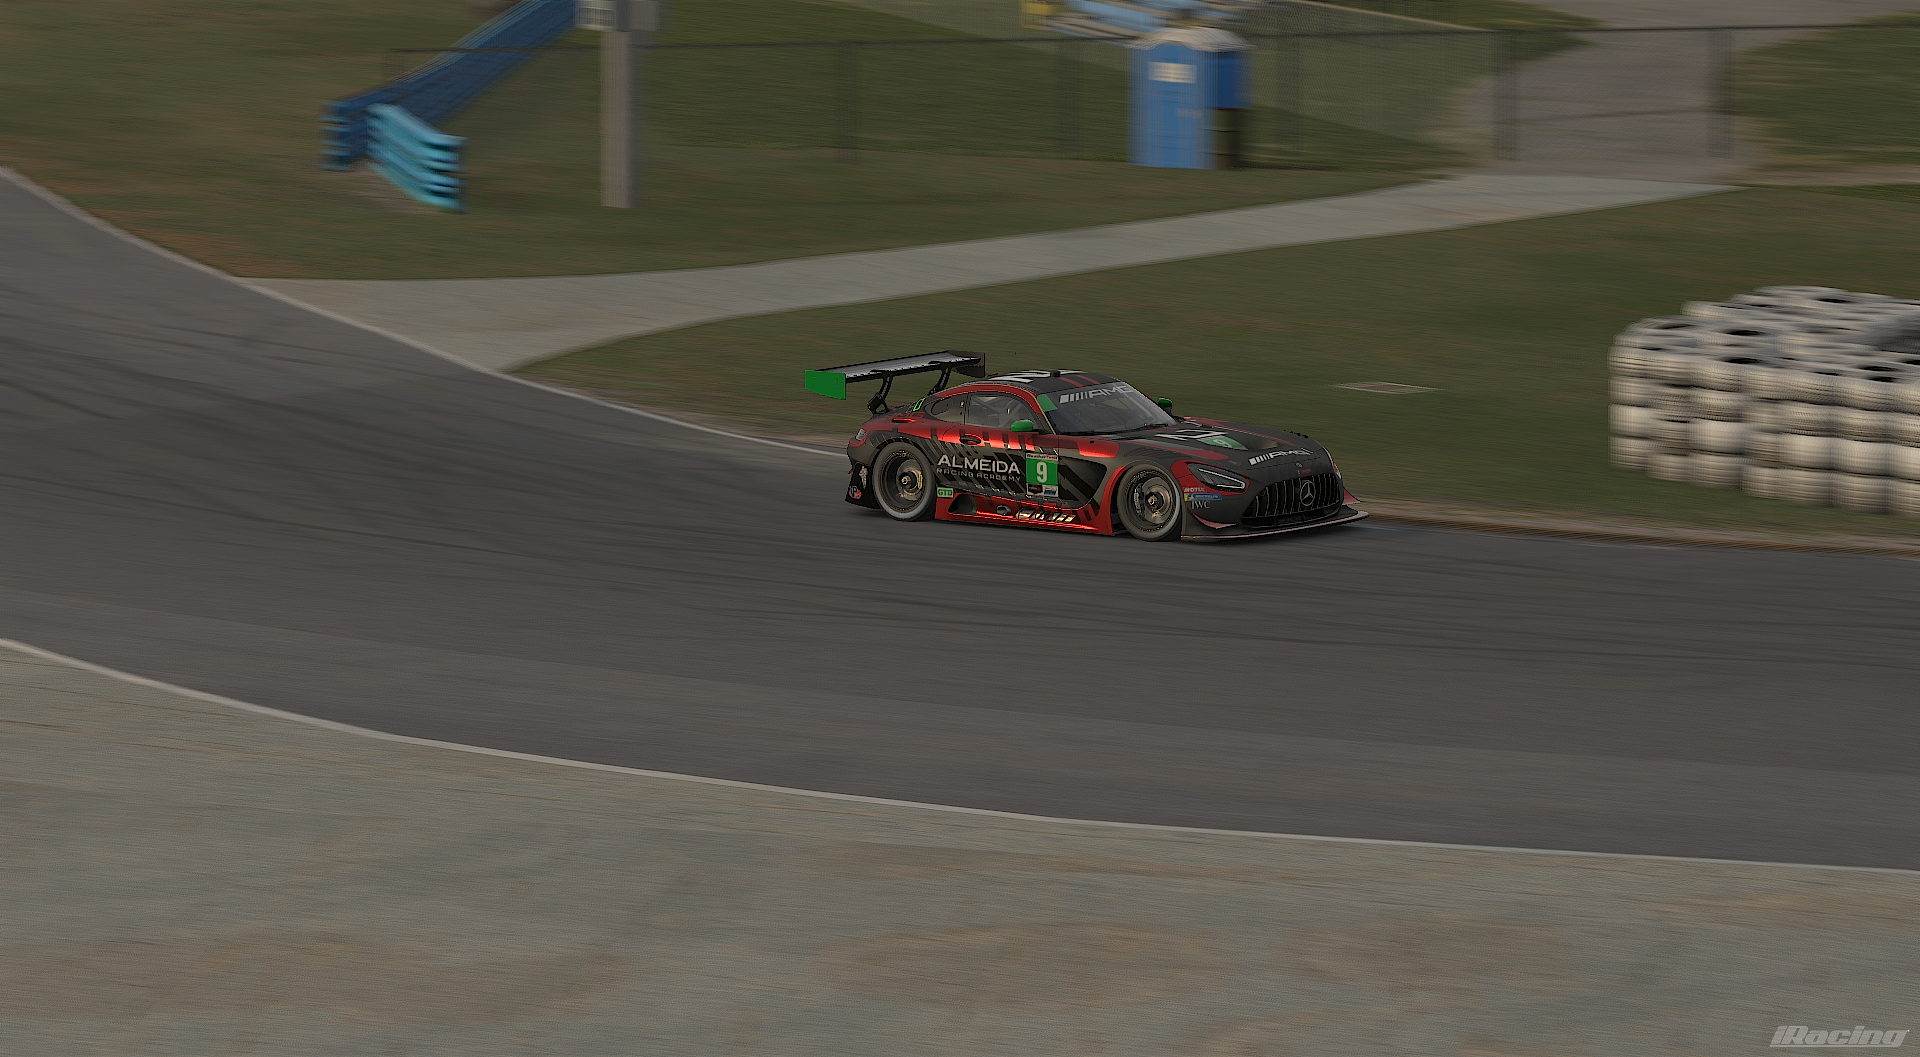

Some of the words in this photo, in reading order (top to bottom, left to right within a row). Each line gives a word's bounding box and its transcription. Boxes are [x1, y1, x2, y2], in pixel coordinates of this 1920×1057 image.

[1089, 385, 1135, 399] AMG
[1212, 438, 1233, 449] 9
[937, 454, 1021, 474] ALMEIDA
[936, 468, 974, 477] RACING
[976, 473, 1021, 482] ACADEMY
[1036, 461, 1048, 483] 9
[937, 488, 953, 497] GTD
[1191, 500, 1211, 510] IWC
